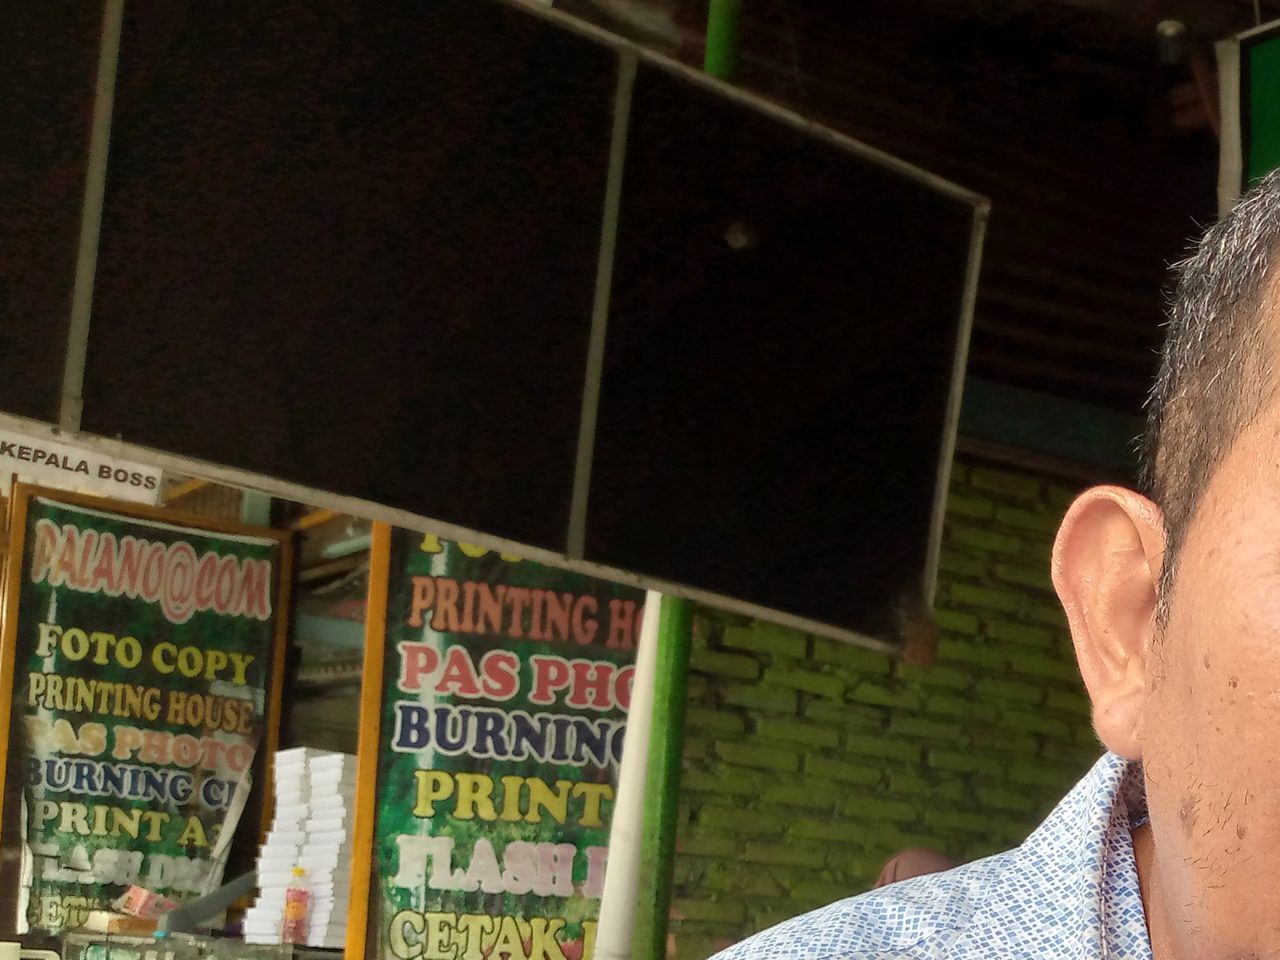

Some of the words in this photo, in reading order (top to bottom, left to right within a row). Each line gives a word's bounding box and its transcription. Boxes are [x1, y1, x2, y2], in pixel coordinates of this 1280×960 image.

[0, 440, 90, 476] KEPALA
[97, 464, 157, 491] BOSS
[408, 576, 599, 645] PRINTING
[36, 622, 142, 670] FOTO
[152, 642, 255, 686] COPY
[398, 641, 520, 700] PAS
[28, 672, 162, 724] PRINTING
[166, 690, 253, 733] HOUSE
[113, 725, 255, 771] PHOTO
[28, 757, 194, 803] BURNING
[413, 769, 616, 828] PRINT
[33, 801, 170, 841] PRINT
